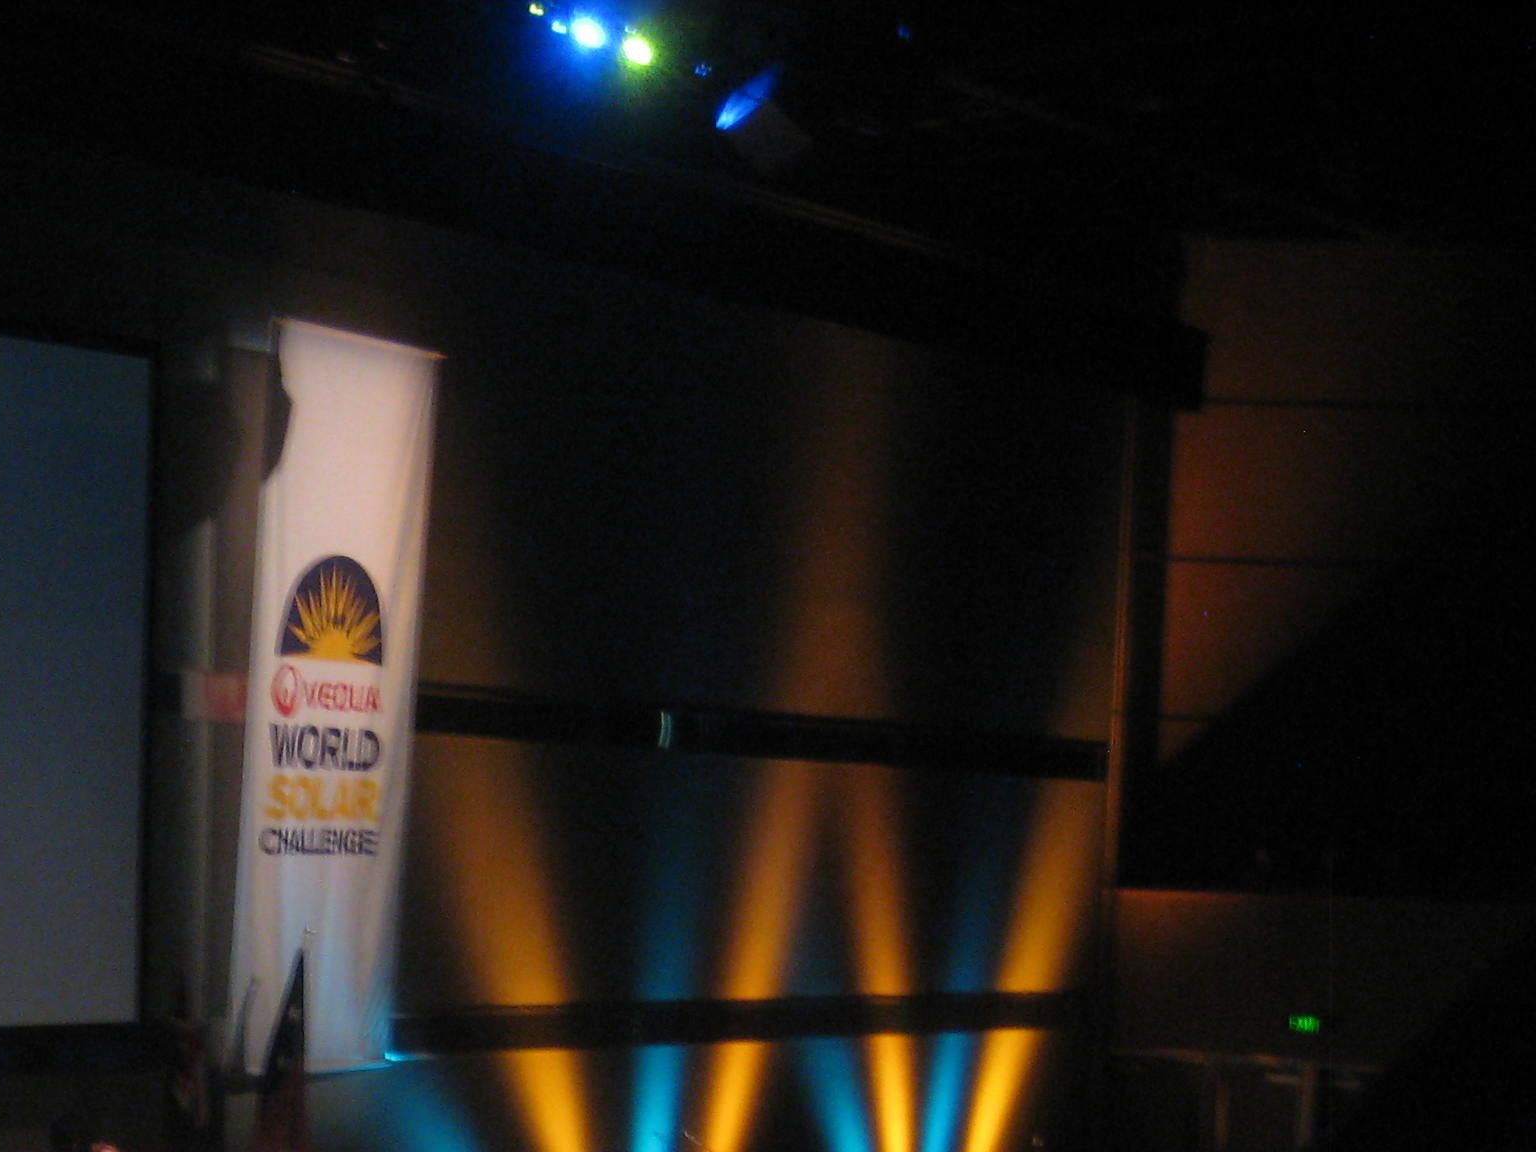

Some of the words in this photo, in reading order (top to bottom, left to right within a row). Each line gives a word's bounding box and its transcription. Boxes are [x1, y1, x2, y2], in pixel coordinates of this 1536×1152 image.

[303, 680, 382, 714] VEOLIA
[269, 723, 380, 771] WORLD
[266, 775, 380, 822] SOLAR
[259, 828, 378, 856] CHALLENGE
